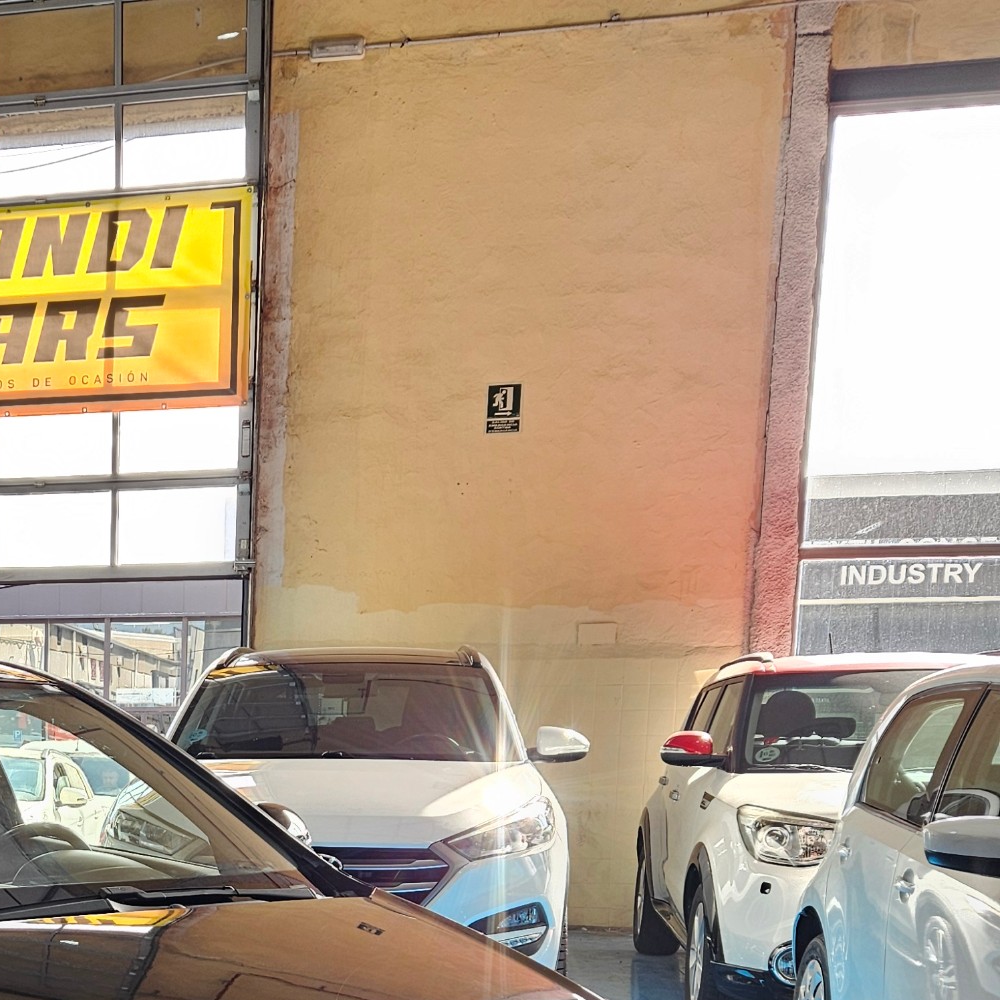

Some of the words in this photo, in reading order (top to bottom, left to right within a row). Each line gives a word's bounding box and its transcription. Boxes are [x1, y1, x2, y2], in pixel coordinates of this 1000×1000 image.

[33, 377, 51, 388] DE
[69, 371, 148, 386] OCASIÓN
[840, 562, 983, 586] INDUSTRY
